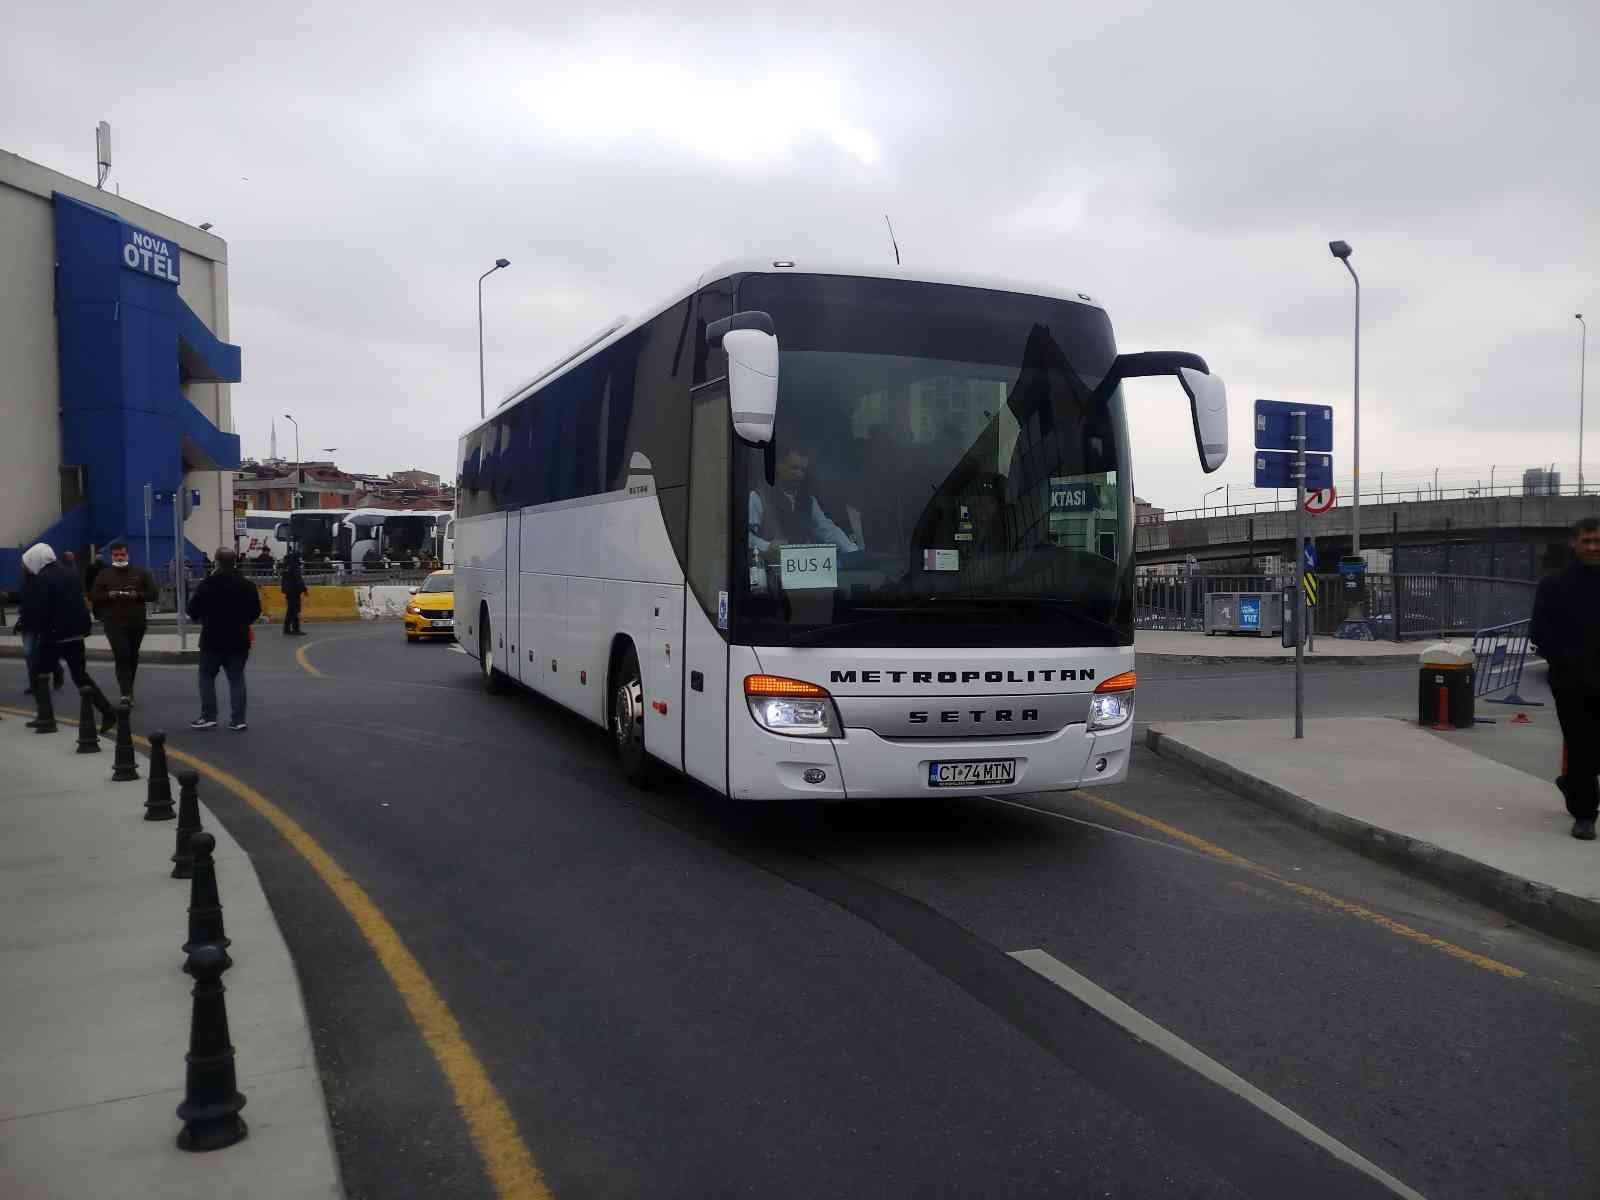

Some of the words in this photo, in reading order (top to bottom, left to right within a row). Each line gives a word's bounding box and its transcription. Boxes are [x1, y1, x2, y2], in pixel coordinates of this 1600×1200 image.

[133, 231, 169, 256] NOVA
[124, 243, 178, 281] OTEL
[786, 558, 818, 573] BUS
[822, 557, 832, 571] 4
[830, 669, 1095, 683] METROPOLITAN
[908, 709, 1038, 723] SETRA
